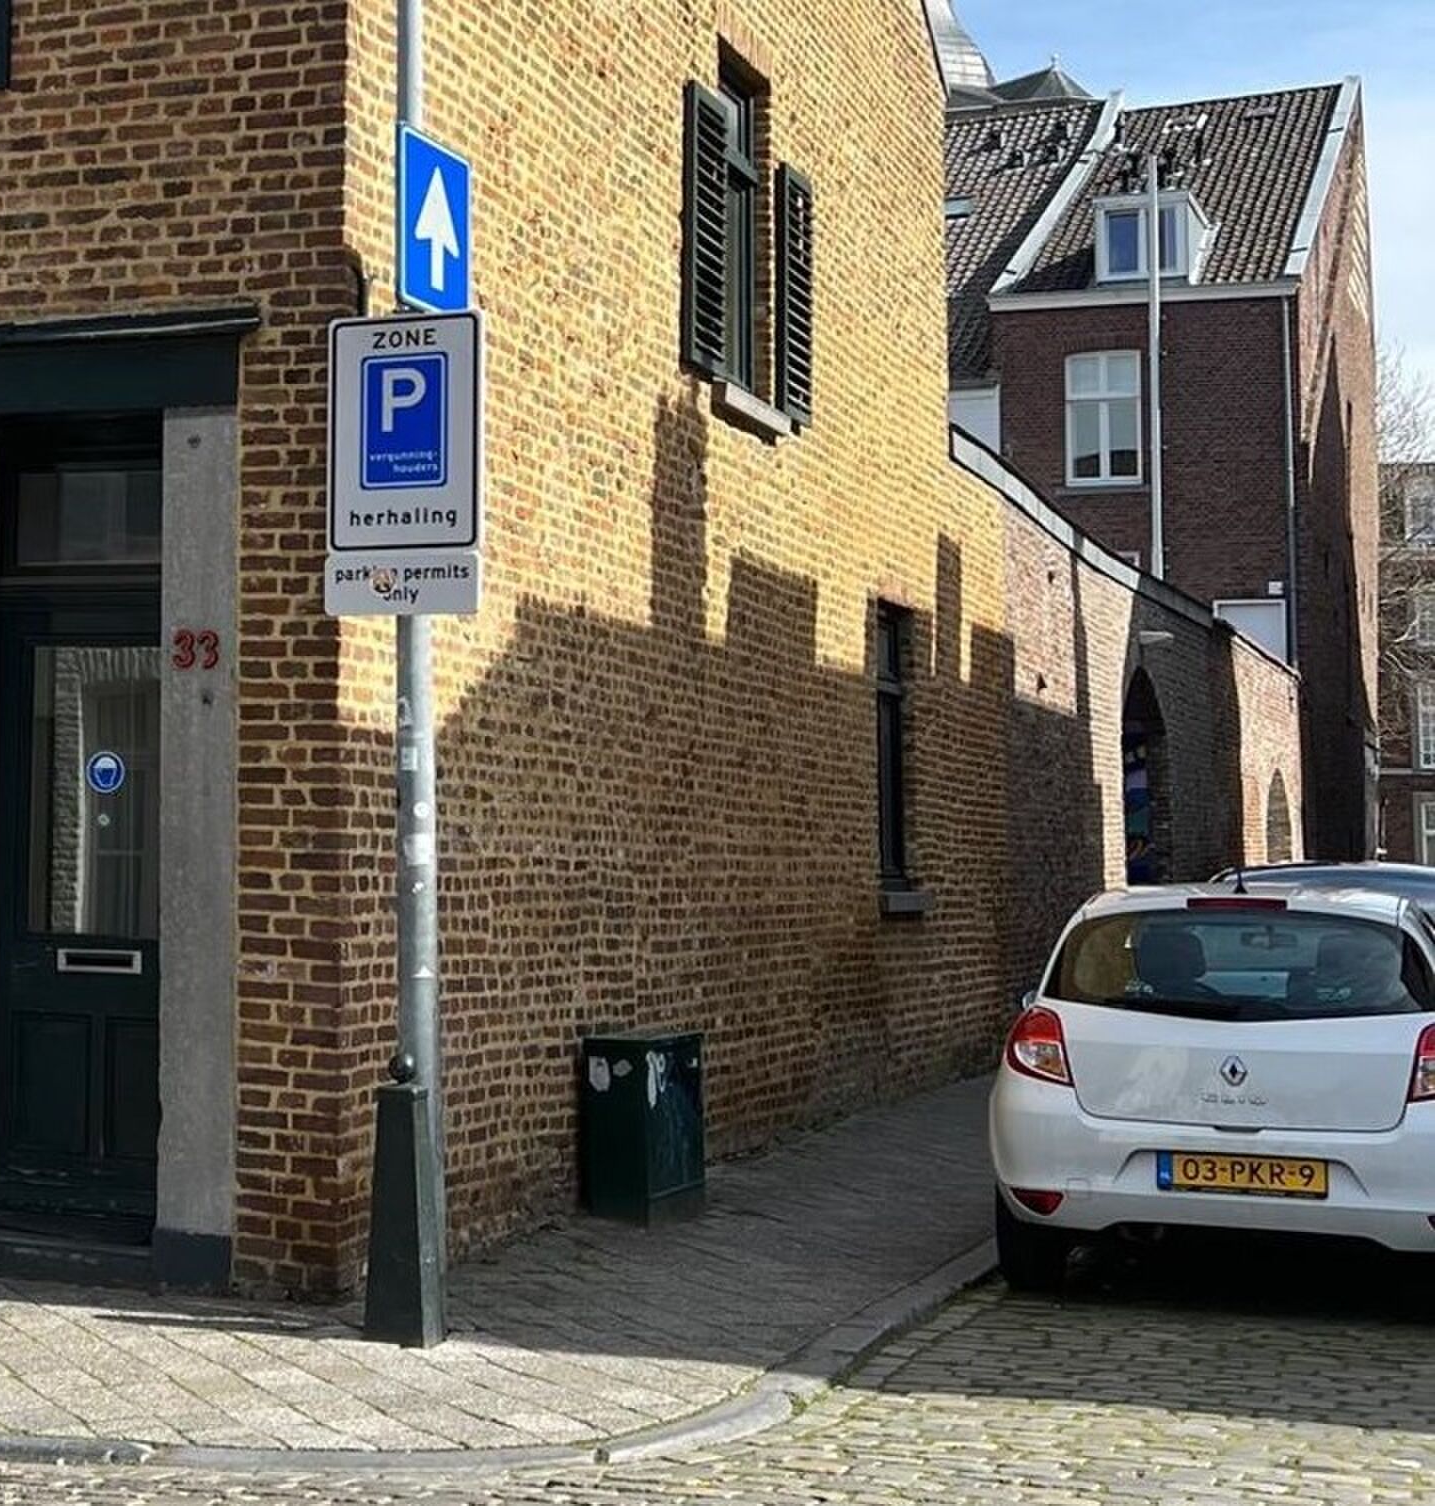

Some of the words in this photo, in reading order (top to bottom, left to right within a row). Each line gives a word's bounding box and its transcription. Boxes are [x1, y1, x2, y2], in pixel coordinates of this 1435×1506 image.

[372, 328, 438, 350] ZONE
[381, 367, 427, 433] P
[349, 508, 458, 528] herhaling
[335, 565, 399, 584] park
[403, 564, 470, 583] permits
[172, 628, 220, 670] 33
[1181, 1157, 1316, 1188] 03-PKR-9
